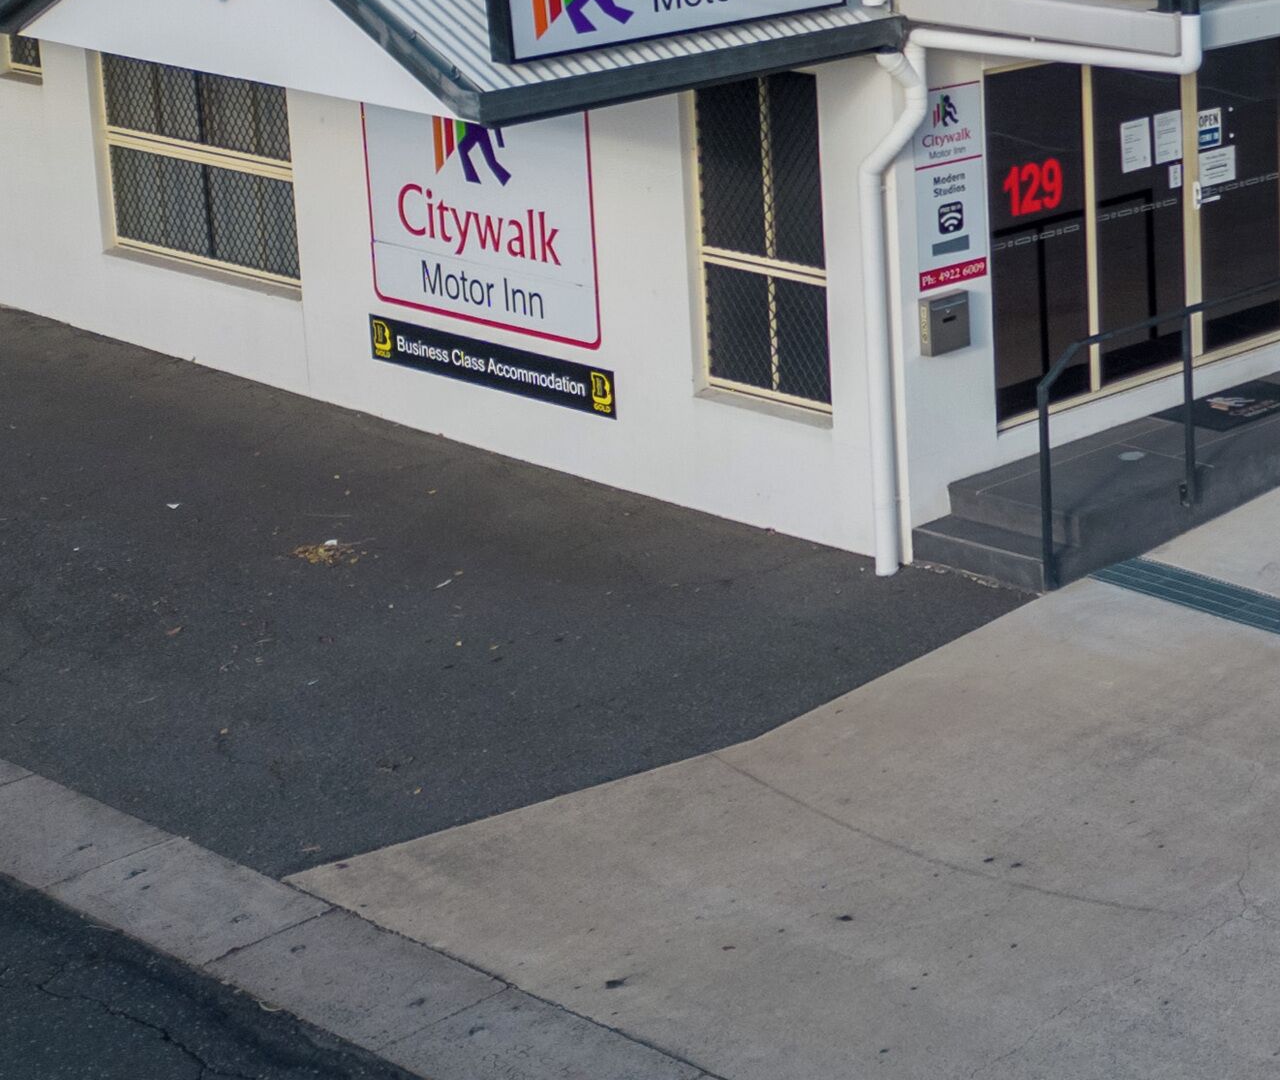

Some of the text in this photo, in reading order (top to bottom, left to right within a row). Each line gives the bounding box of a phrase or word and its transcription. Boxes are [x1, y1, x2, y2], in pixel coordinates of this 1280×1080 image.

[1199, 111, 1219, 128] OPEN
[922, 127, 971, 149] Citywalk
[929, 148, 952, 159] Motor
[933, 172, 966, 186] Modern
[1003, 158, 1063, 216] 129
[933, 184, 966, 198] Studios
[397, 183, 562, 267] Citywalk
[939, 267, 961, 282] 4922
[421, 260, 544, 319] Motor Inn
[397, 335, 449, 363] Business
[451, 350, 485, 372] Class
[487, 358, 585, 397] Accommodation
